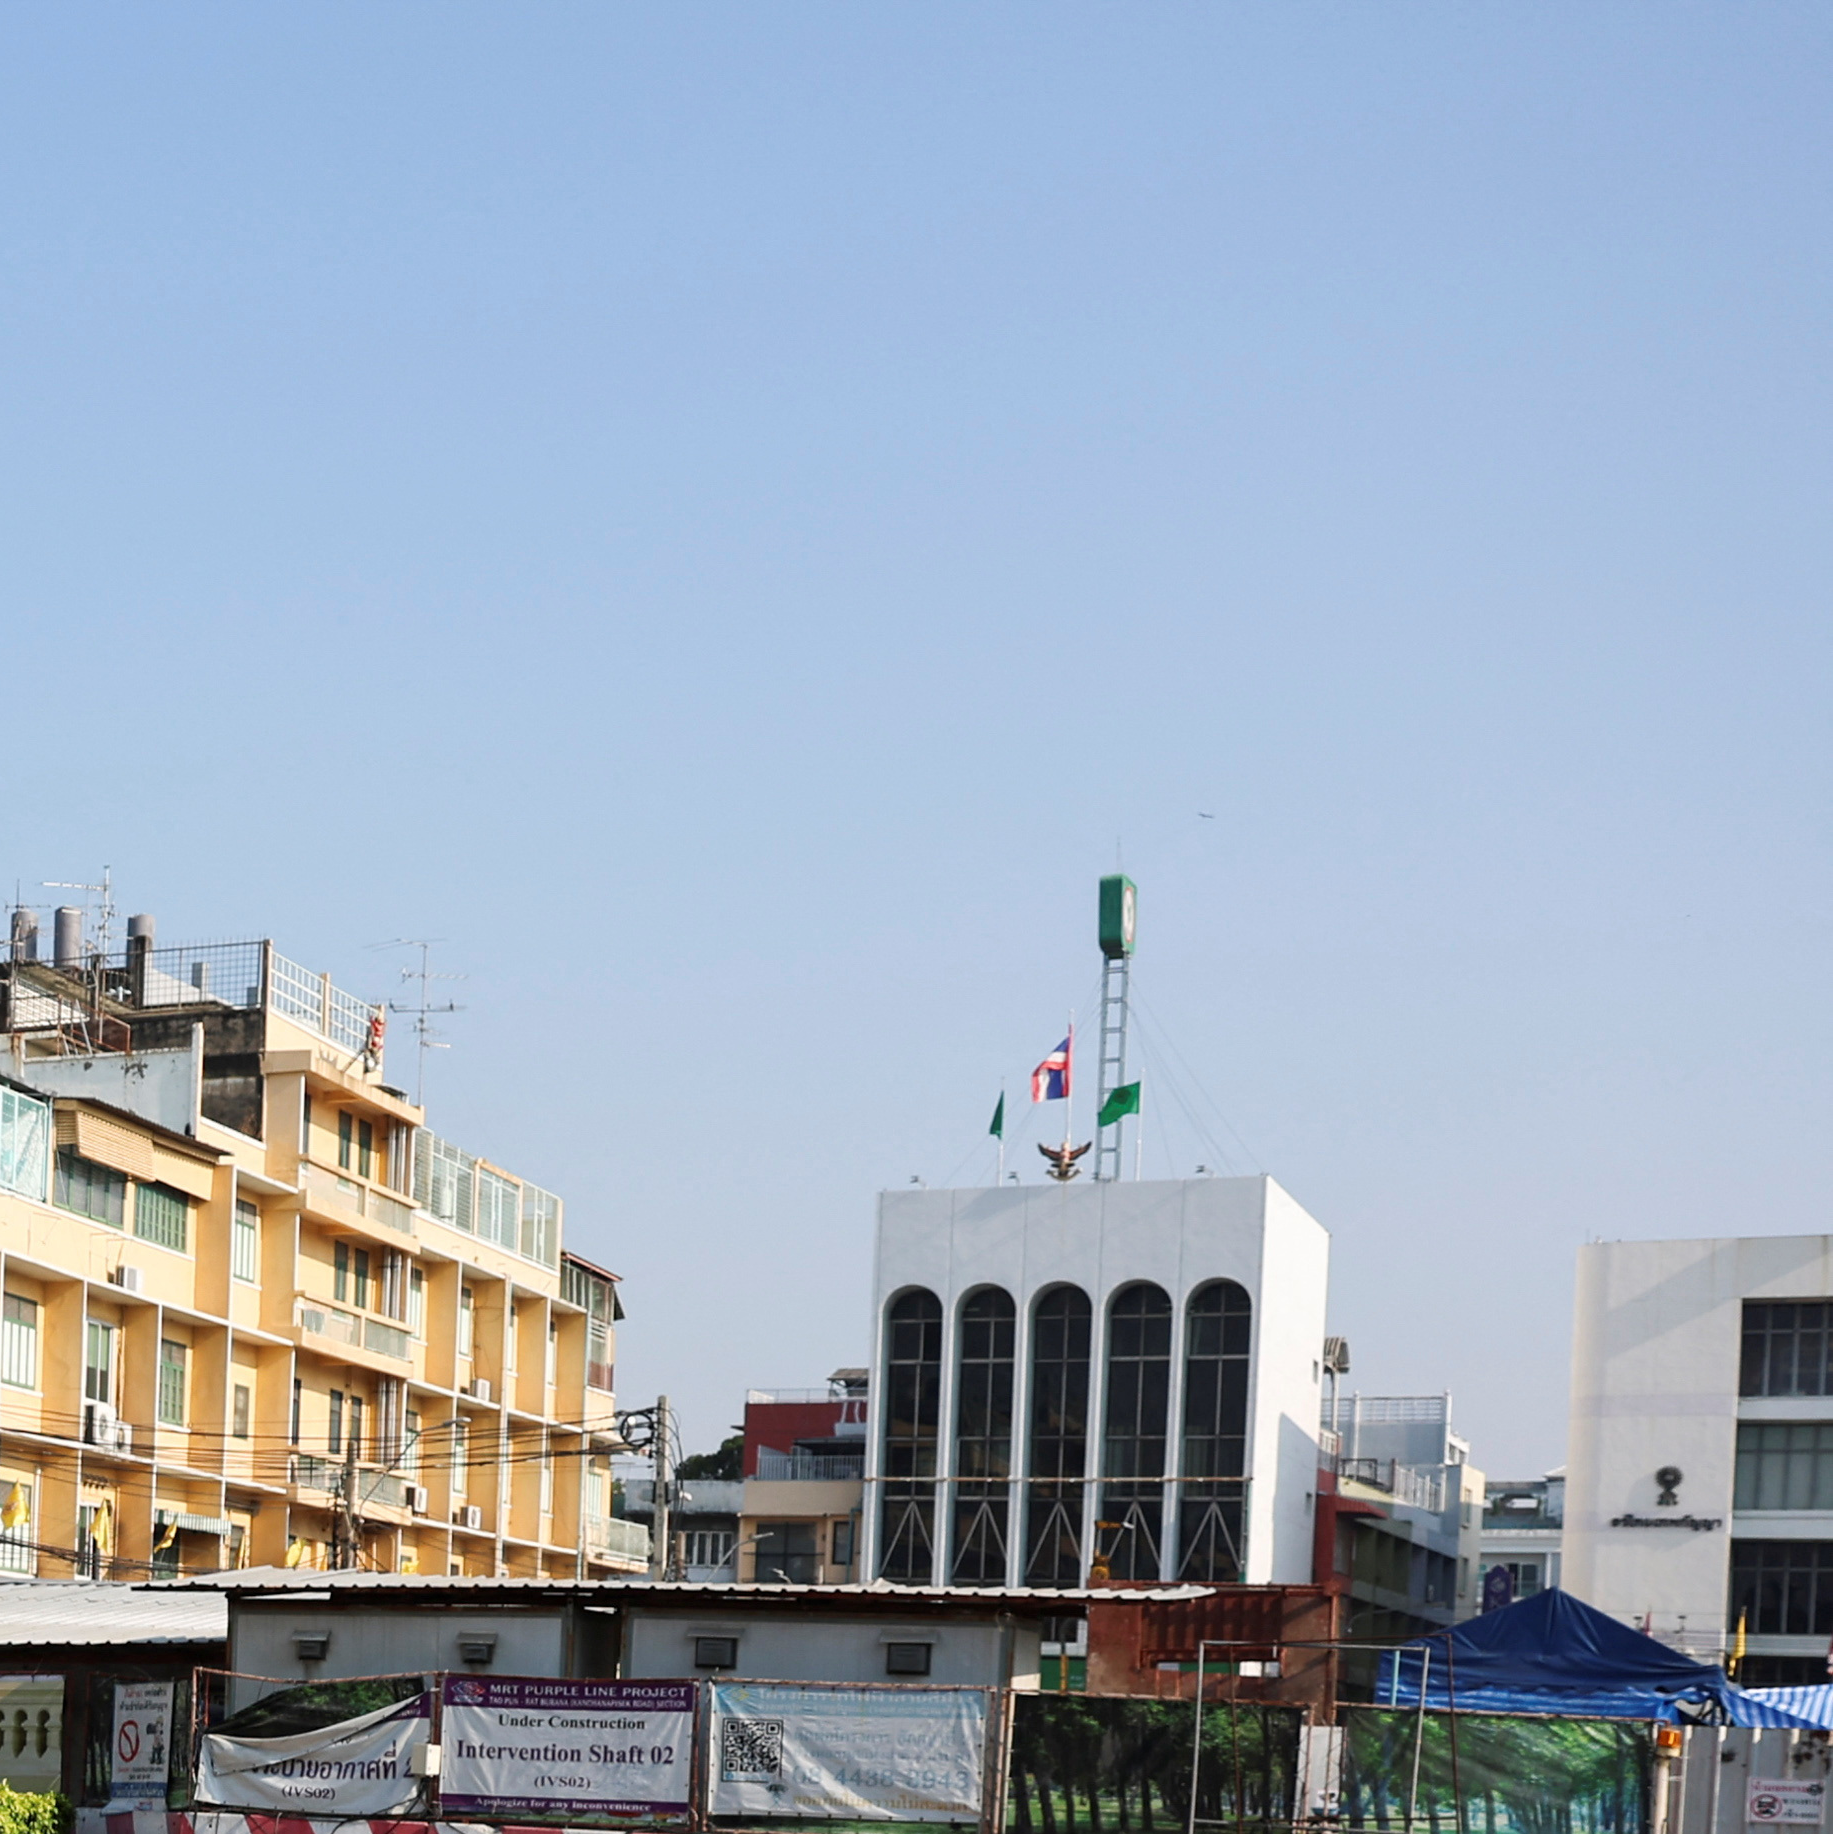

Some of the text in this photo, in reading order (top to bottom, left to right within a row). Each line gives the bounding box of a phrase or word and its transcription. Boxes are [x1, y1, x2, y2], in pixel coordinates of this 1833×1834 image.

[490, 1684, 688, 1698] MRT PURPLE LINE PROJECT
[499, 1714, 645, 1730] Under Construction
[252, 1739, 397, 1780] ะบายอากาศที่
[456, 1740, 674, 1765] Intervention Shaft 02
[534, 1776, 591, 1789] (IVS02)
[282, 1784, 336, 1800] (IVS02)
[476, 1798, 651, 1812] Apologize for any inconvenience
